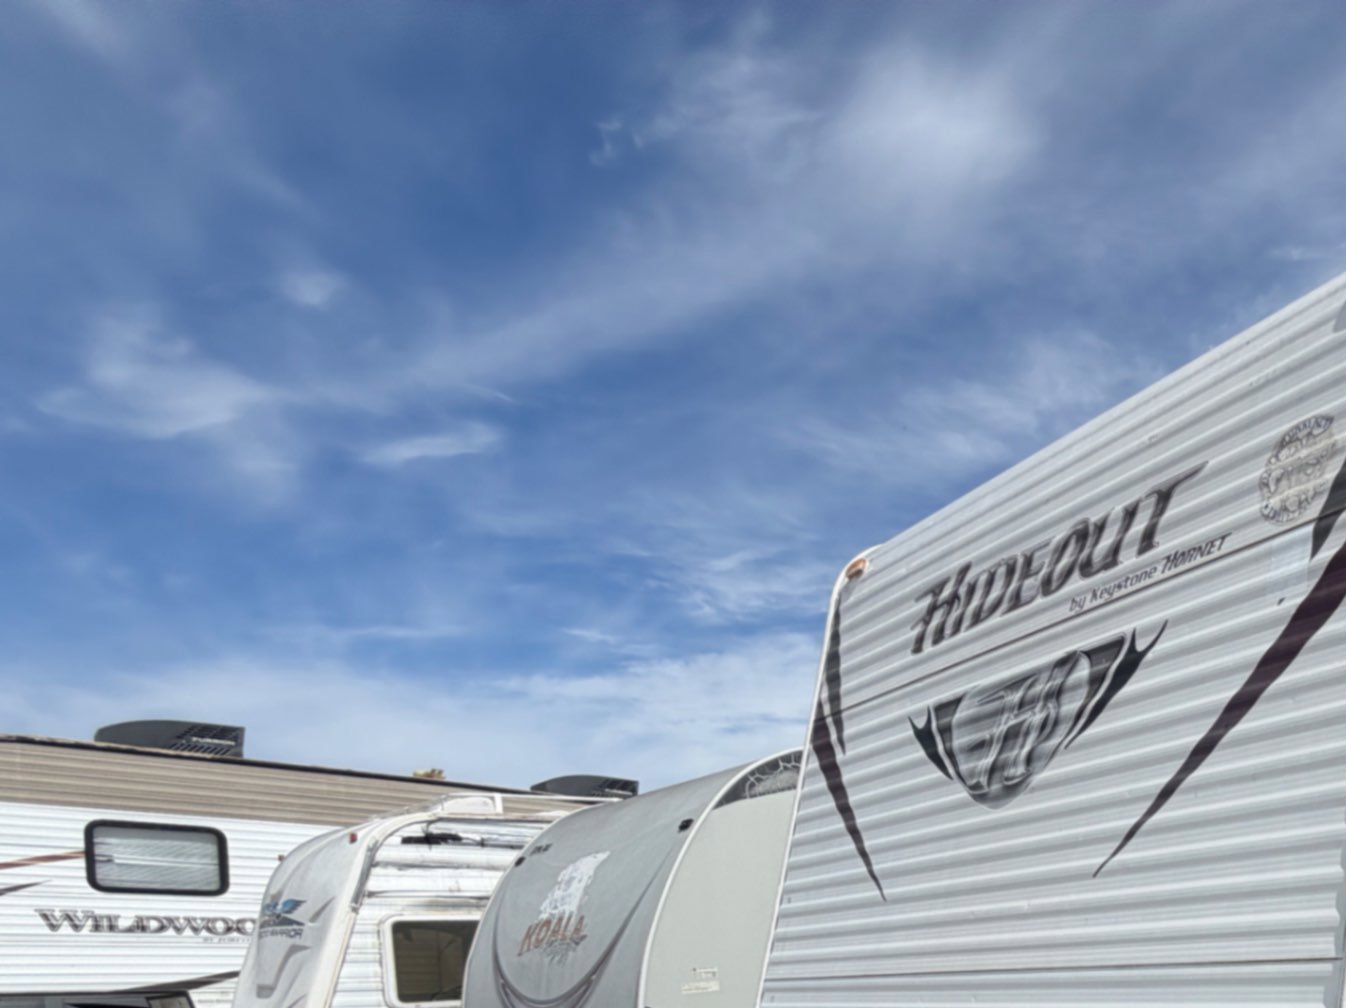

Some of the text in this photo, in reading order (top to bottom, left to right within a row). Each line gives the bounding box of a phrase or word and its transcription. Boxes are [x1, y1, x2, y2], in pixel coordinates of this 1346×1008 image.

[911, 461, 1209, 654] HIDEOUT
[1069, 531, 1233, 612] by Keystone HORNET
[35, 907, 257, 937] WILDWOO
[517, 911, 585, 957] KOALA
